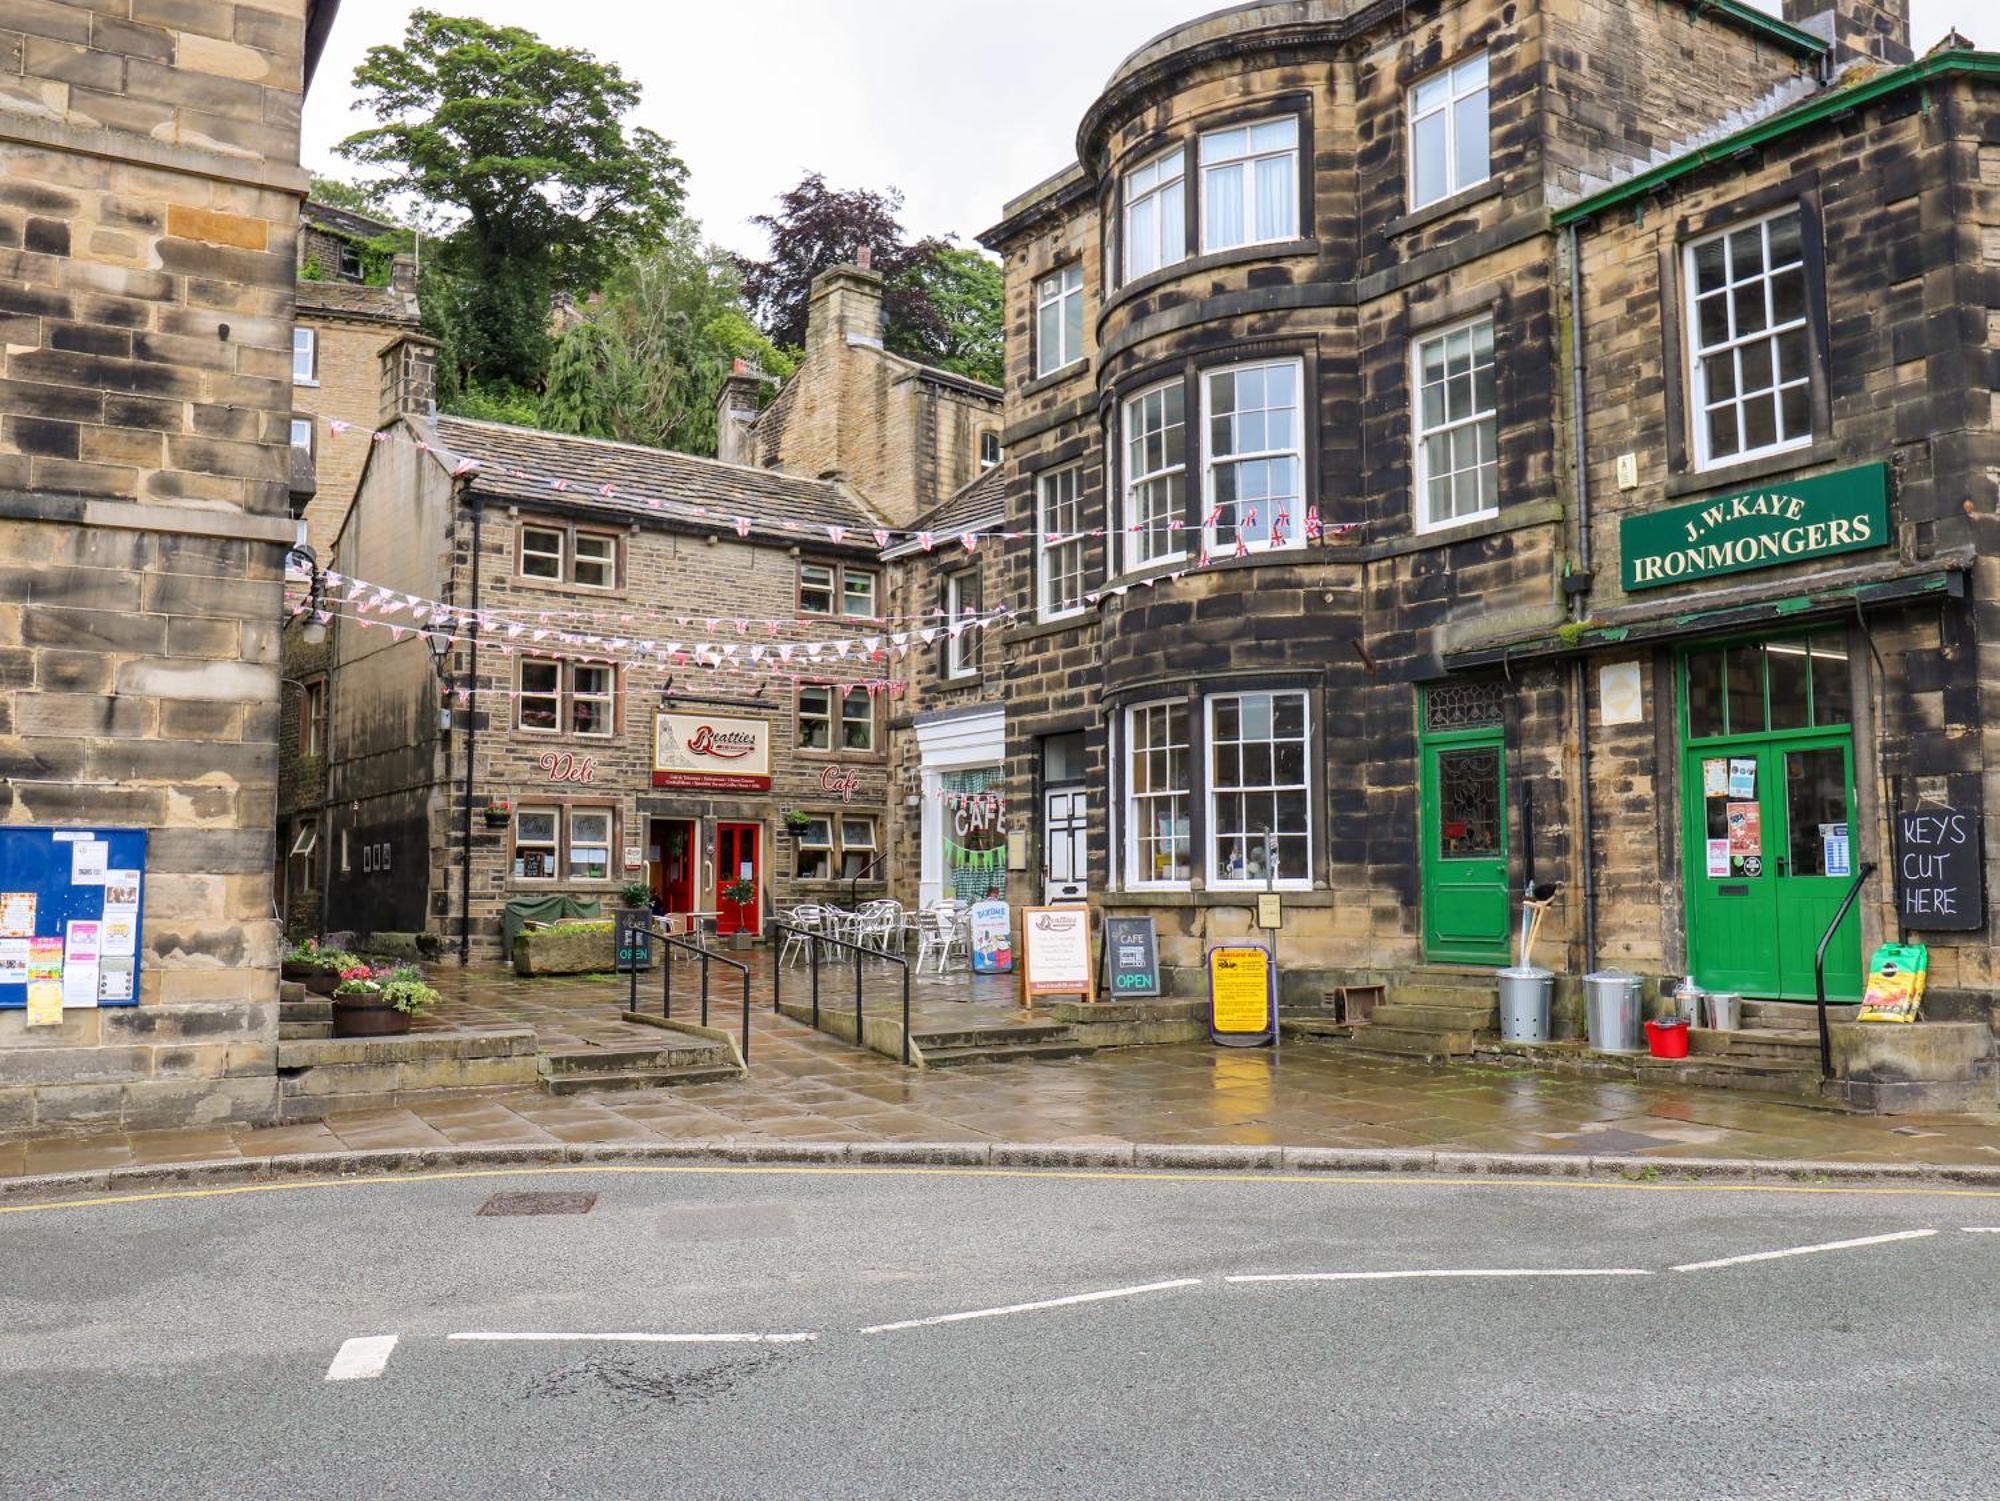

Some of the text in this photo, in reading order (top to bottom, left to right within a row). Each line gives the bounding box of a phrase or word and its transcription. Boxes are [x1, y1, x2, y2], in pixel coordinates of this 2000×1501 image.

[1633, 515, 1871, 583] IRONMONGERS
[688, 724, 756, 758] Beatties
[540, 751, 598, 784] Deli
[955, 805, 1006, 836] CAFE
[1904, 815, 1966, 845] KEYS
[1903, 853, 1951, 880] CUT
[1906, 887, 1957, 915] HERE
[1120, 934, 1144, 944] CAFE
[1116, 974, 1152, 989] OPEN
